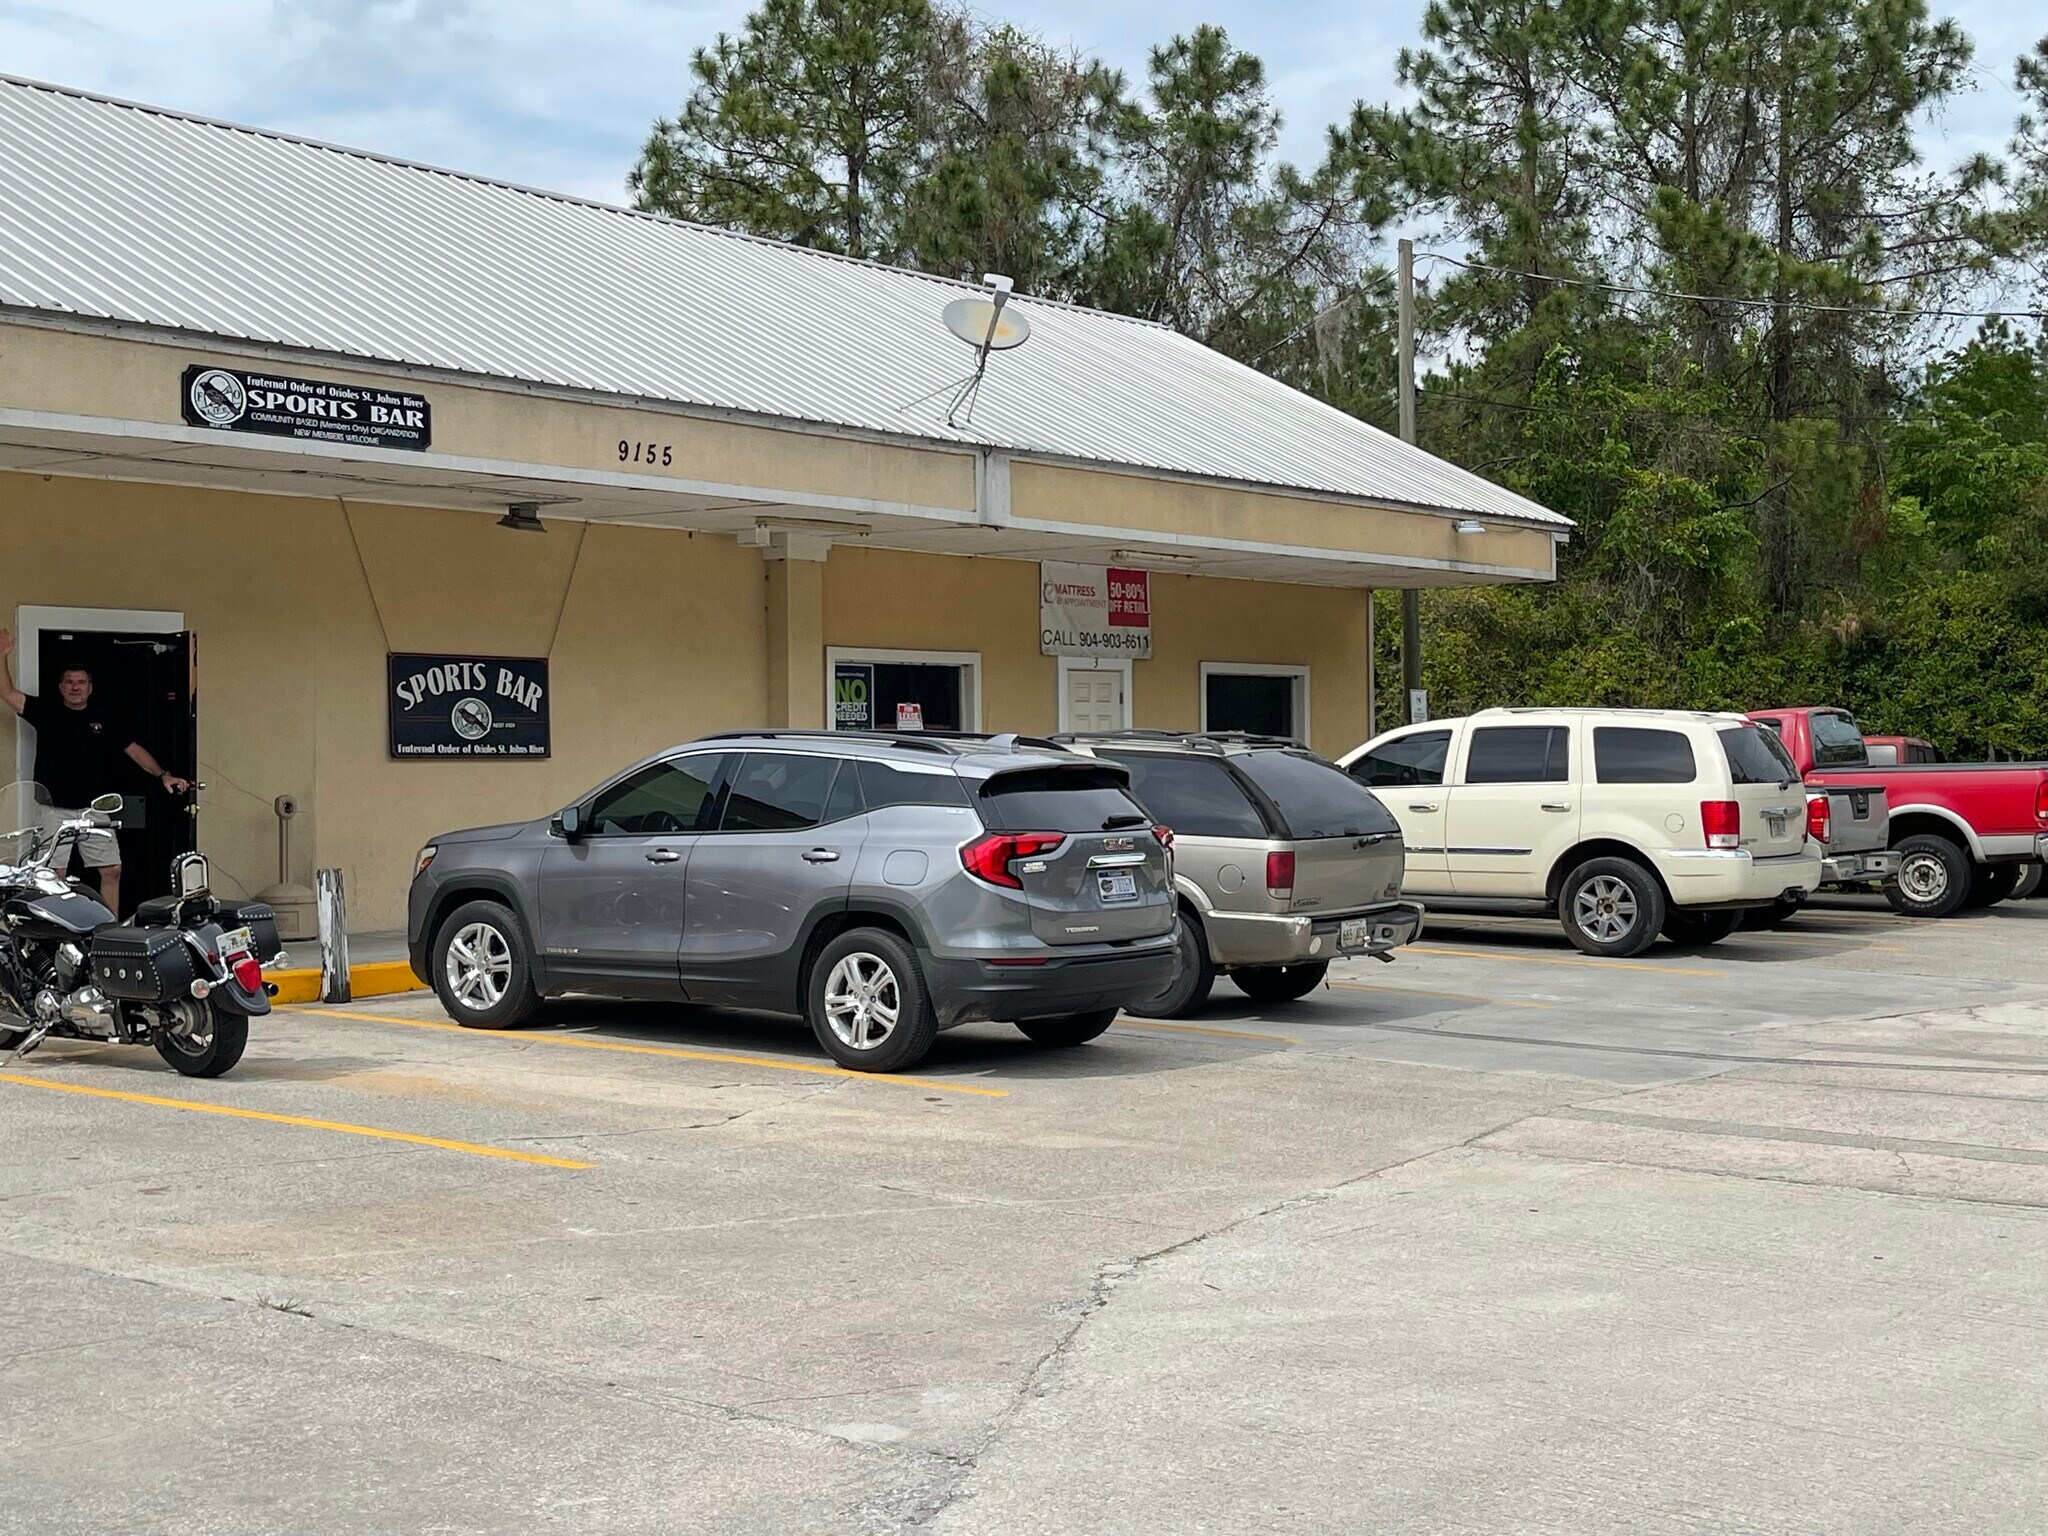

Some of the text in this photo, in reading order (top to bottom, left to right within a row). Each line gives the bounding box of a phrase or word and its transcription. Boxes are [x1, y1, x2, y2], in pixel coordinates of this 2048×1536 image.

[246, 375, 424, 409] Fraternal Order of Orioles St. Johns River
[248, 390, 424, 428] SPORTS BAR
[251, 412, 295, 425] COMMUNITY
[295, 417, 318, 428] BASED
[370, 426, 419, 439] ORGANIZATION
[294, 428, 380, 445] NEW MEMBERS WELCOME
[618, 440, 672, 466] 9155
[1054, 583, 1096, 597] MATTRESS
[1110, 582, 1146, 600] 50-80%
[1108, 600, 1122, 613] OFF
[1042, 629, 1076, 646] CALL
[396, 662, 543, 713] SPORTS BAR
[835, 679, 867, 703] NO
[835, 702, 868, 712] CREDIT
[397, 743, 435, 754] Fraternal
[437, 743, 460, 754] Order
[462, 743, 472, 754] of
[474, 743, 497, 754] Orioles
[509, 743, 528, 754] Johns
[529, 743, 545, 754] River
[1103, 837, 1134, 851] GMC
